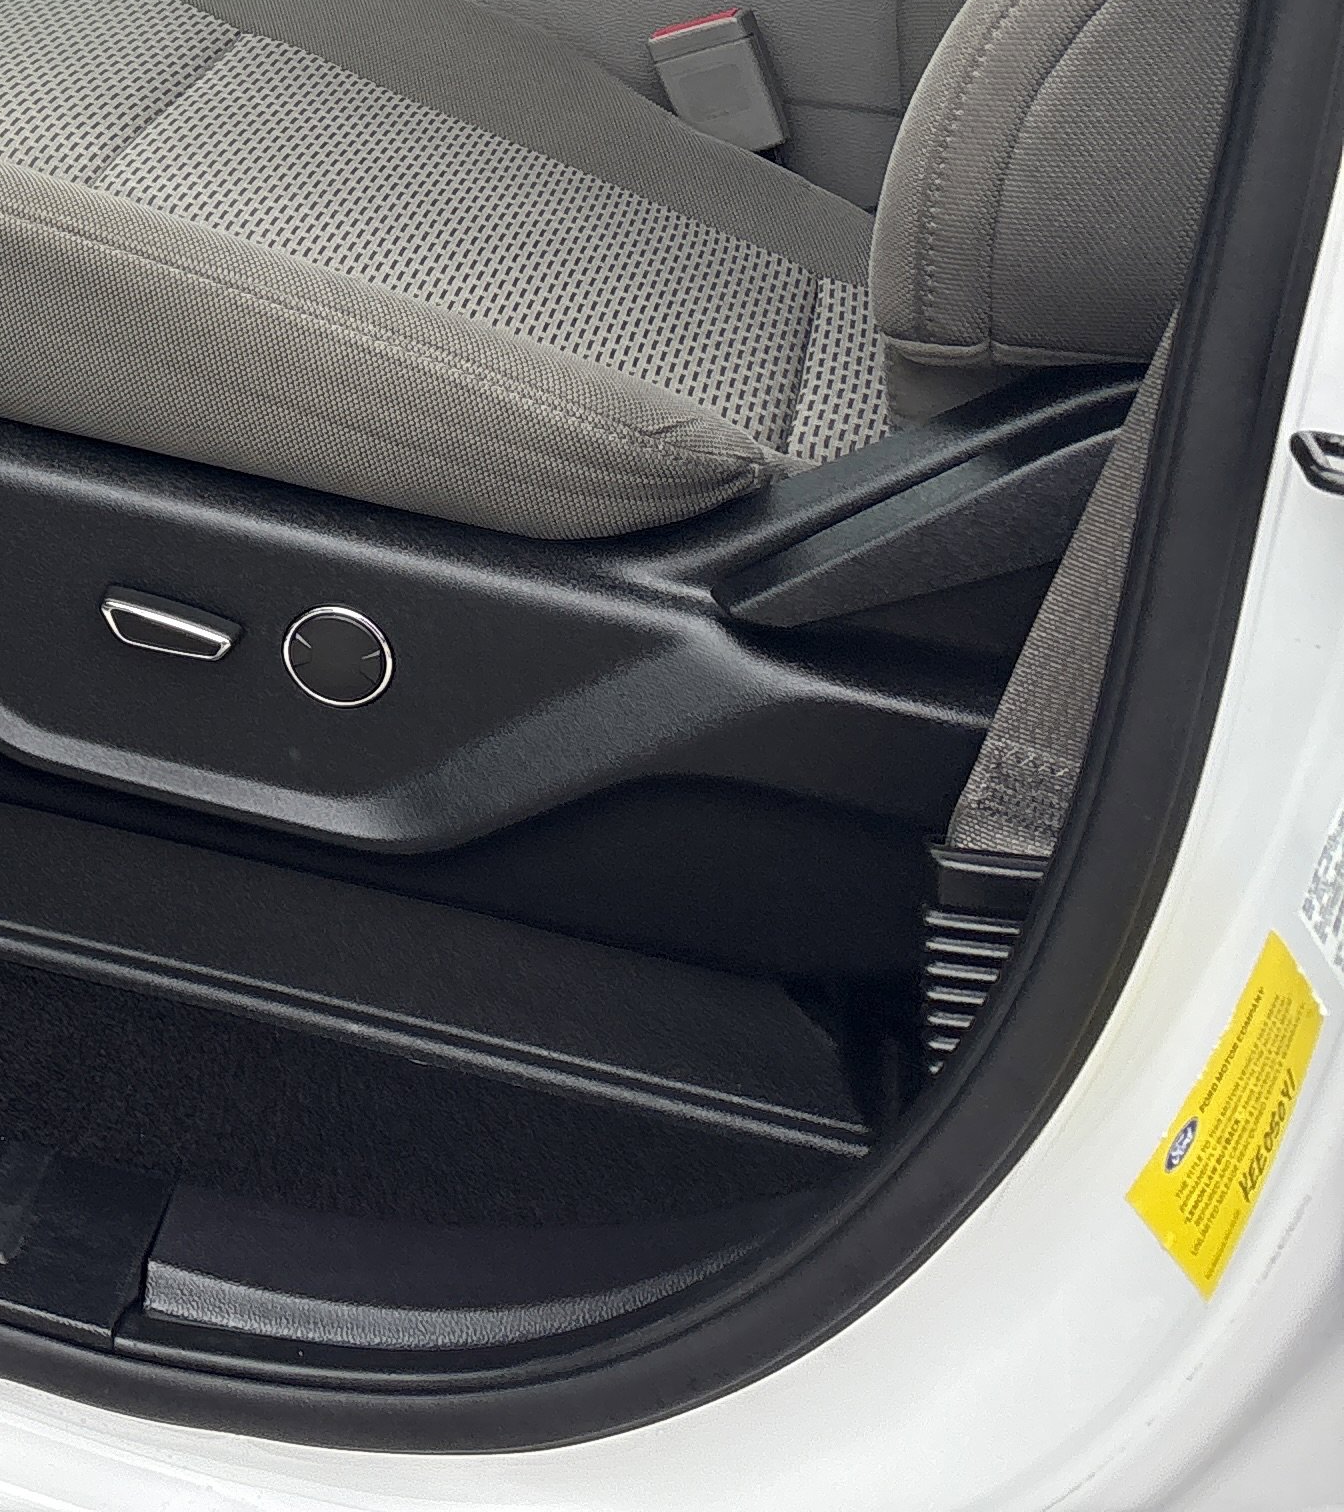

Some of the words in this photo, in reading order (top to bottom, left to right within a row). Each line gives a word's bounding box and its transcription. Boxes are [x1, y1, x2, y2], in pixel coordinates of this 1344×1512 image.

[1199, 1082, 1217, 1113] FORD
[1216, 1042, 1238, 1082] MOTOR
[1235, 986, 1265, 1041] COMPANY
